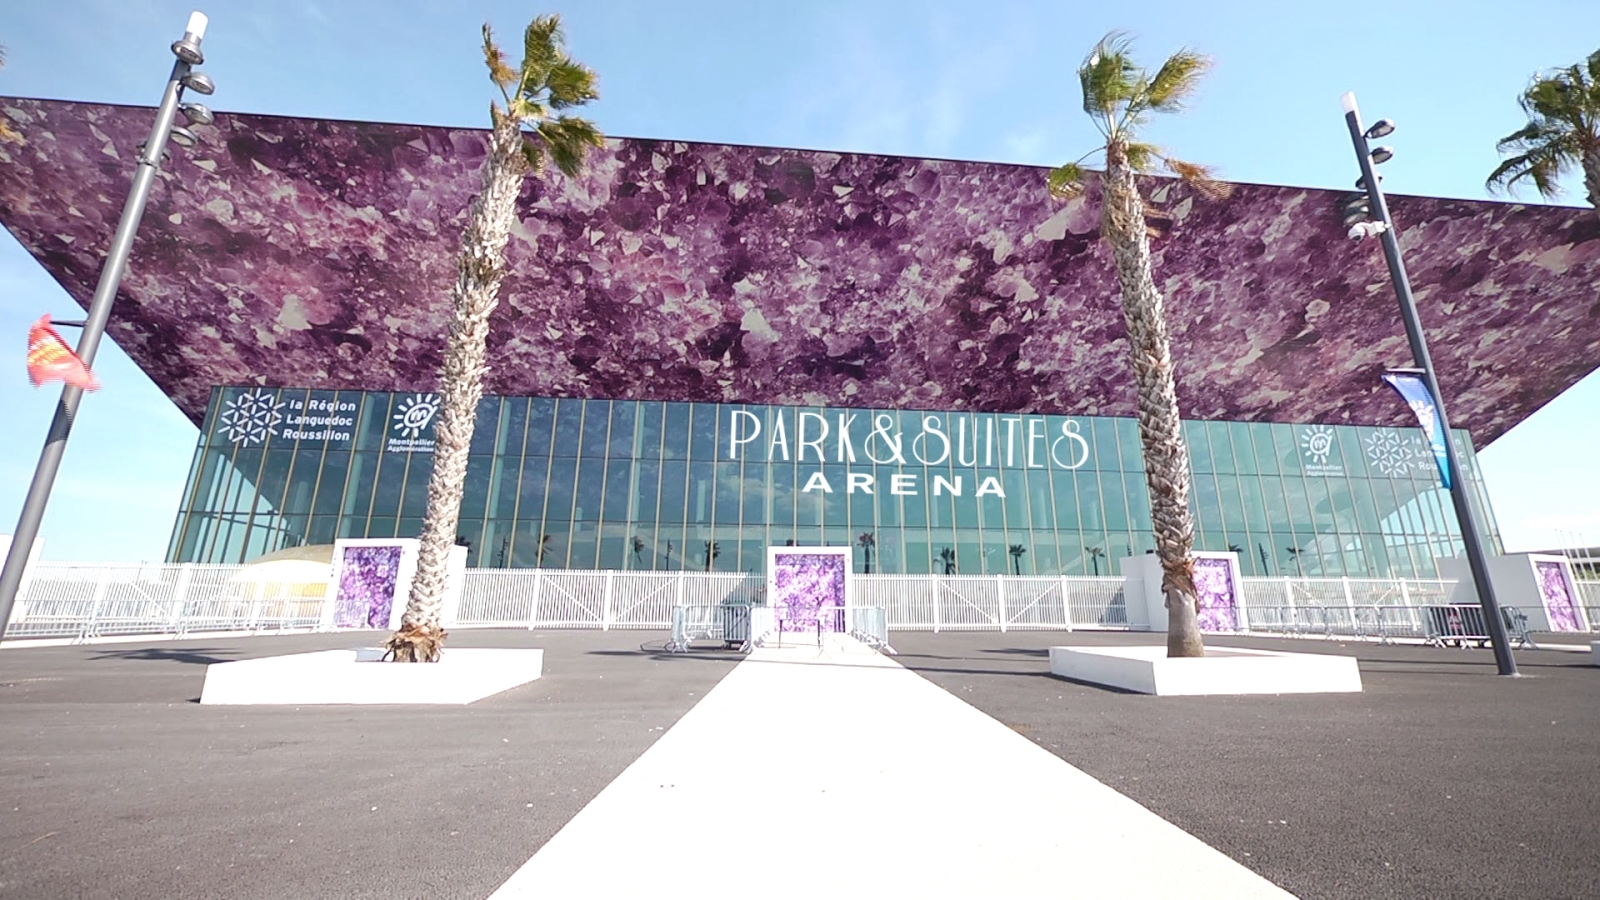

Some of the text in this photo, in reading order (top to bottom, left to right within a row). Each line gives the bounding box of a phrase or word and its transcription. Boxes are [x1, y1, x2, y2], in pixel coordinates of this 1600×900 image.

[289, 399, 356, 412] la Région
[286, 413, 353, 427] Languedoc
[282, 428, 350, 441] Roussillon
[801, 471, 1007, 498] ARENA
